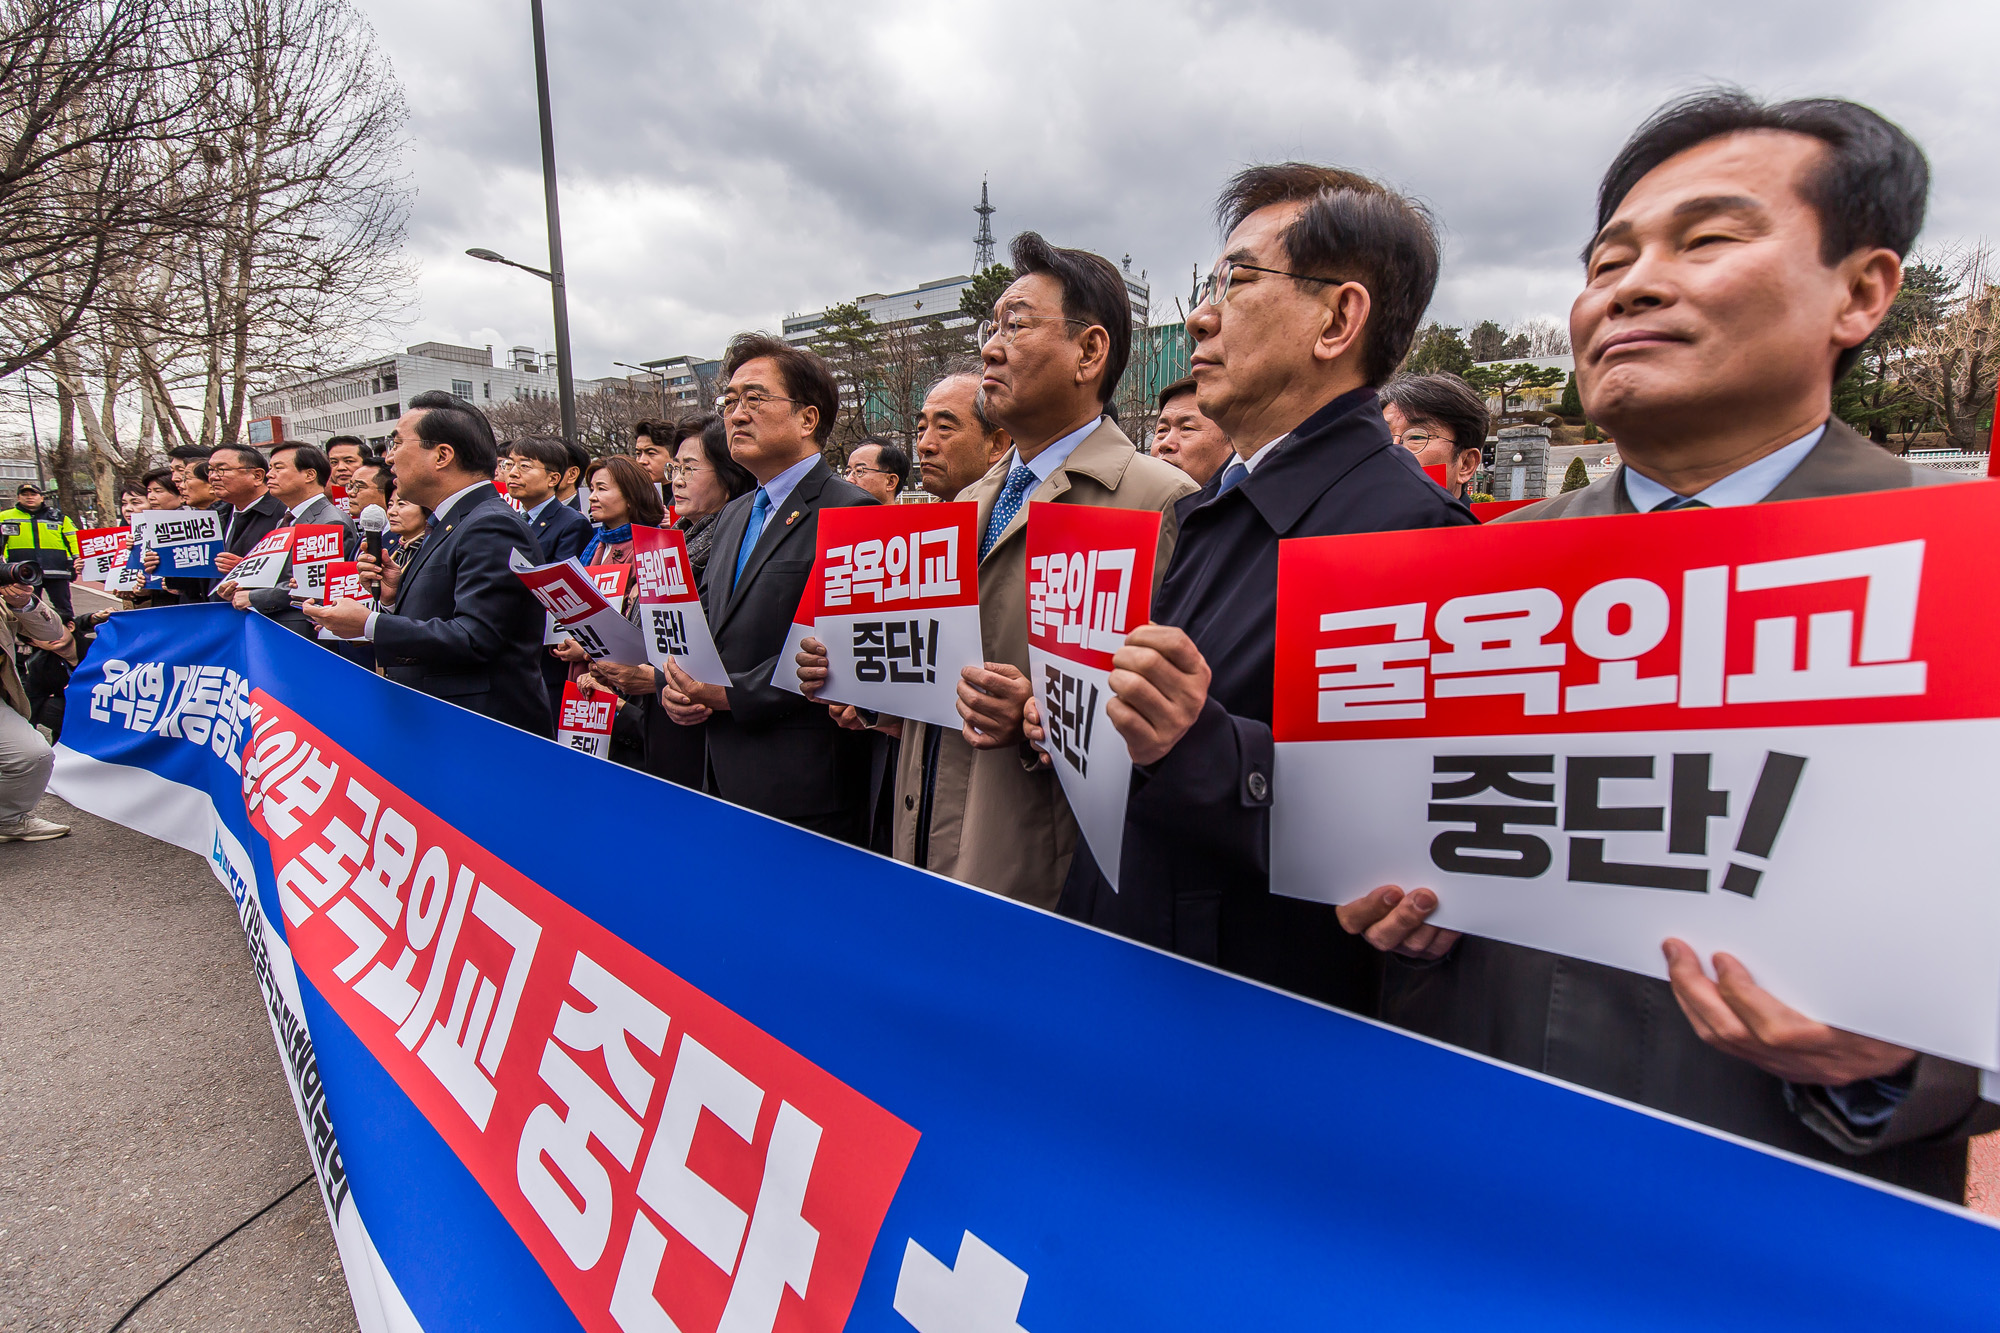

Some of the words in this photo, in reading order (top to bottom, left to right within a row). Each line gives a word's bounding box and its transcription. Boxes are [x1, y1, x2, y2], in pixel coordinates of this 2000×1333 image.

[155, 517, 216, 544] 셀프배상
[173, 544, 209, 568] 철회!
[296, 532, 339, 561] 굴욕외교
[635, 546, 689, 597] 굴욕외교
[824, 525, 961, 607] 굴욕외교
[652, 609, 689, 656] 중단!
[1029, 548, 1136, 654] 굴욕외교
[1315, 538, 1928, 723] 굴욕외교
[852, 618, 939, 685] 중단!
[563, 699, 611, 730] 굴욕외교
[1045, 663, 1099, 779] 중단!
[1427, 749, 1809, 899] 중단!
[90, 659, 165, 733] 윤석열
[151, 665, 251, 777] 대통령은
[277, 777, 542, 1133] 굴욕외교
